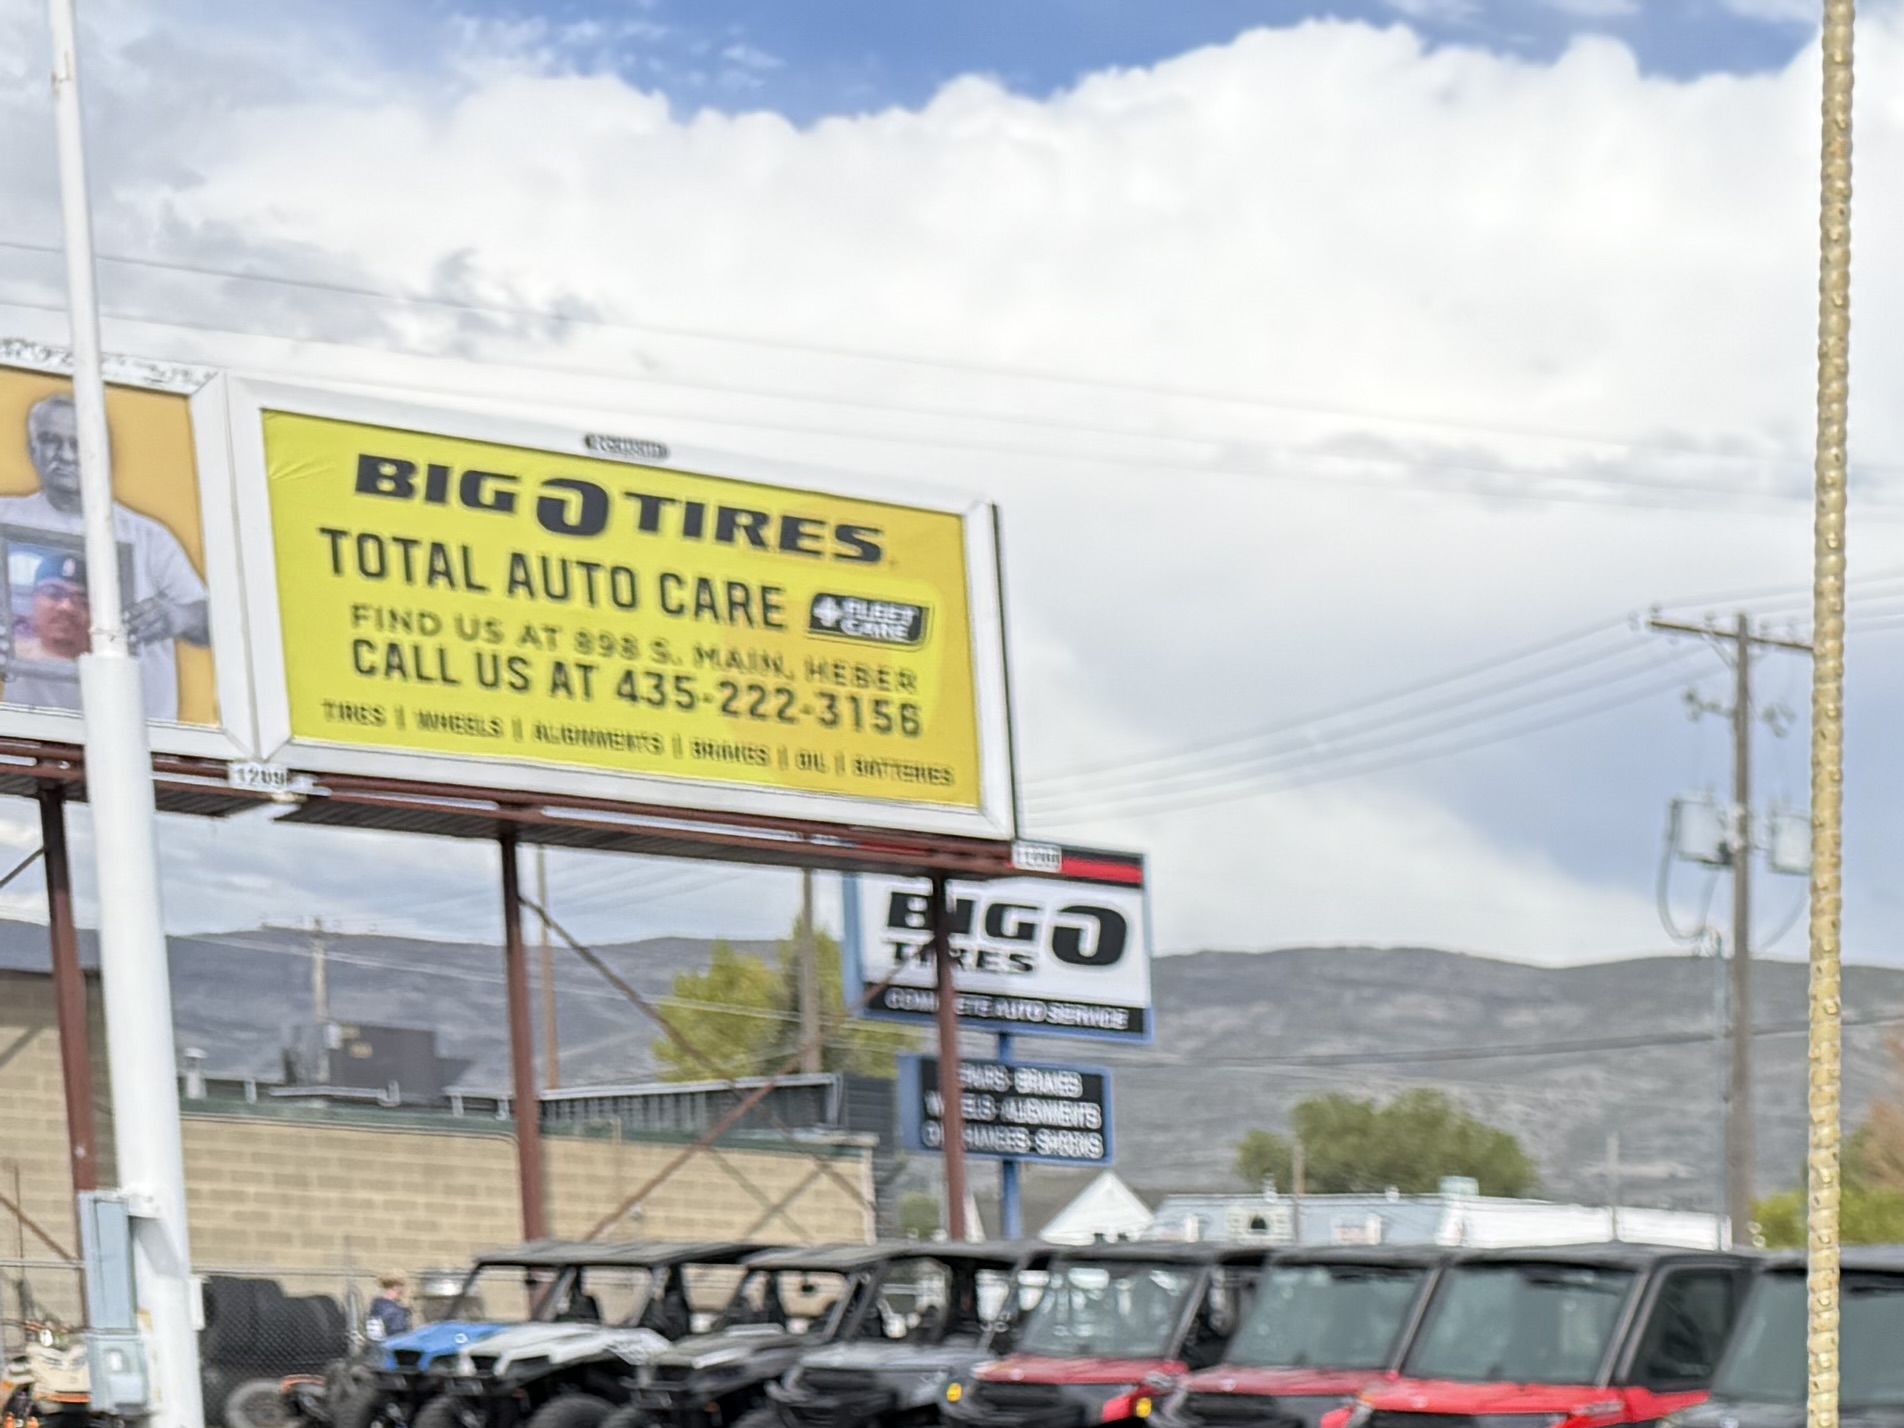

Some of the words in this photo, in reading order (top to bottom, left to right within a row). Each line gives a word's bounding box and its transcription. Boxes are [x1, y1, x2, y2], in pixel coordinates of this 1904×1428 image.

[355, 453, 520, 515] BIG
[624, 490, 885, 563] TIRES
[319, 526, 489, 591] TOTAL
[508, 552, 638, 609] AUTO
[660, 571, 785, 629] CARE
[352, 604, 442, 637] FIND
[455, 612, 504, 644] US
[520, 625, 558, 649] AT
[806, 658, 918, 693] HEBER
[353, 638, 461, 686] CALL
[474, 650, 530, 692] US
[551, 660, 598, 701] AT
[617, 669, 921, 738] 435-222-3156
[324, 699, 385, 727] TIRES
[416, 709, 502, 738] WHEELS
[887, 891, 1041, 941] BIG
